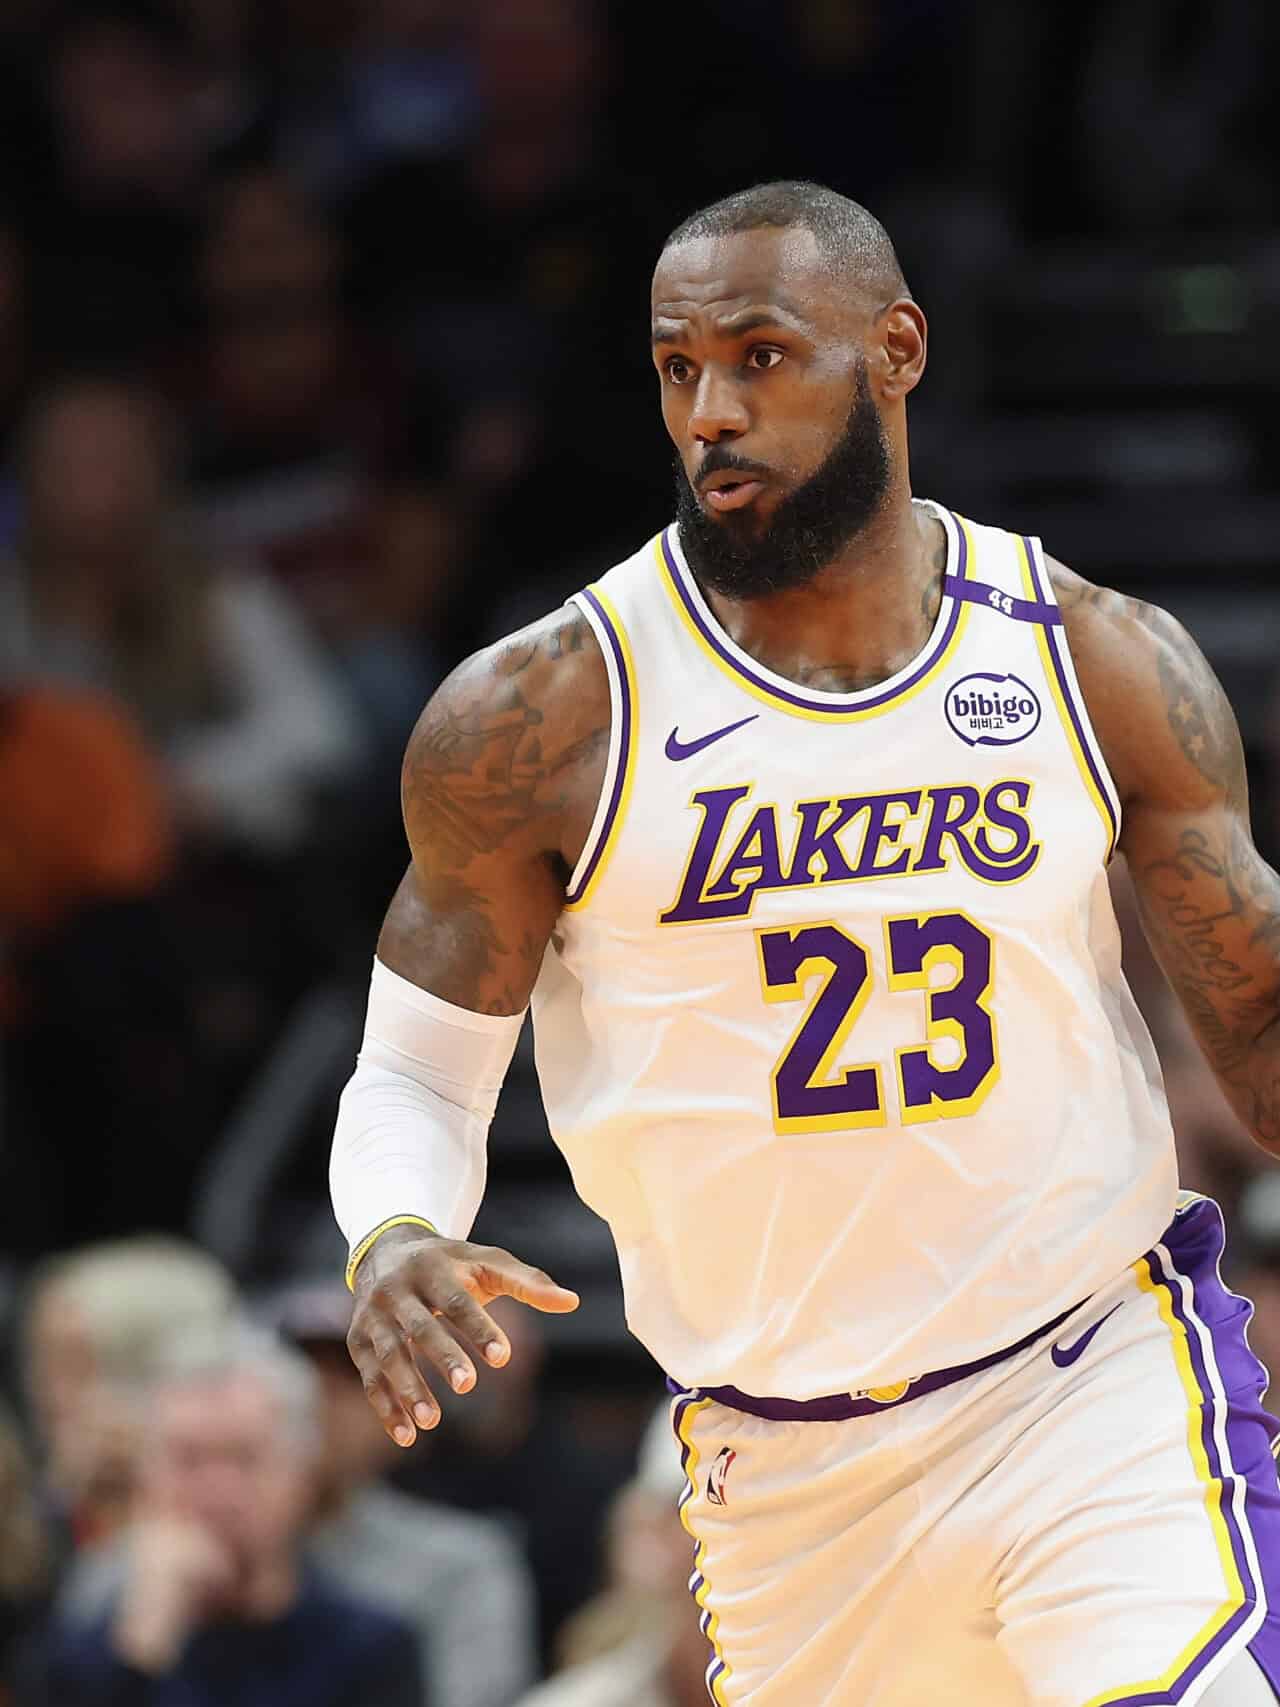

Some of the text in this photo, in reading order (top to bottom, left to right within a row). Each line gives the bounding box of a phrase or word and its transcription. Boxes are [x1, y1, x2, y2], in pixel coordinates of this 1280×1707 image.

[988, 589, 1014, 615] 44
[953, 692, 1034, 723] bibigo
[969, 717, 1005, 729] 비비고
[655, 778, 1044, 928] LAKERS
[754, 908, 1004, 1136] 23
